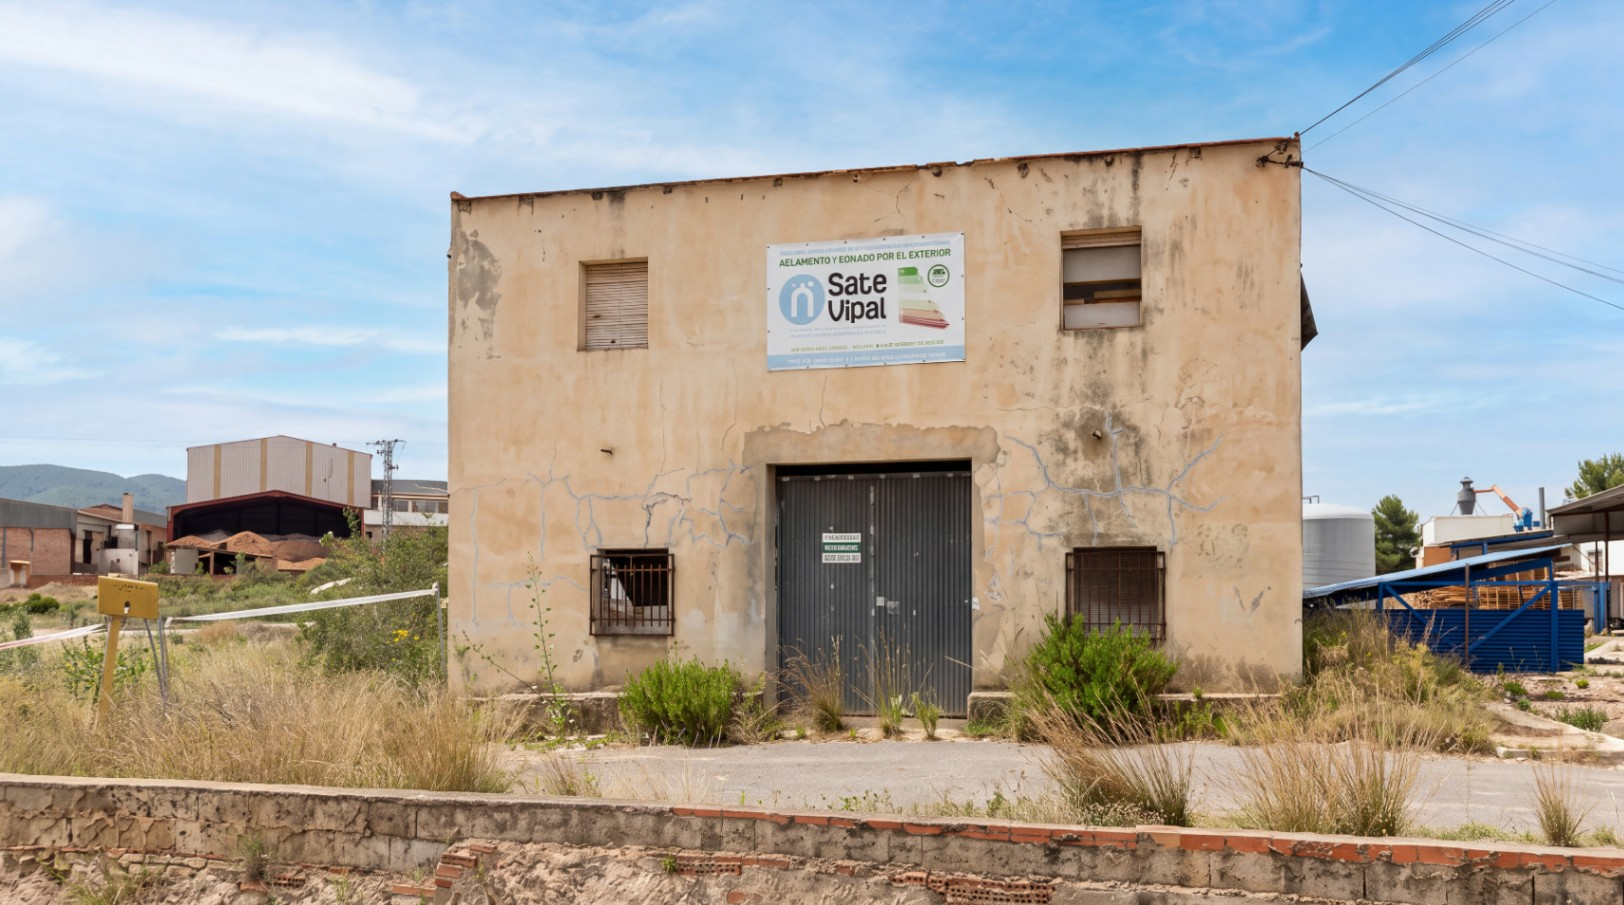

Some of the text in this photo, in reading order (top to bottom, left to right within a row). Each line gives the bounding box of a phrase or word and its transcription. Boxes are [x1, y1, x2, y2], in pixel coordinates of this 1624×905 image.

[779, 256, 831, 267] AELAMENTO
[832, 255, 838, 264] Y
[876, 252, 895, 261] POR
[896, 251, 907, 260] EL
[908, 248, 951, 259] EXTERIOR
[828, 272, 887, 297] Sate
[828, 296, 887, 323] Vipal
